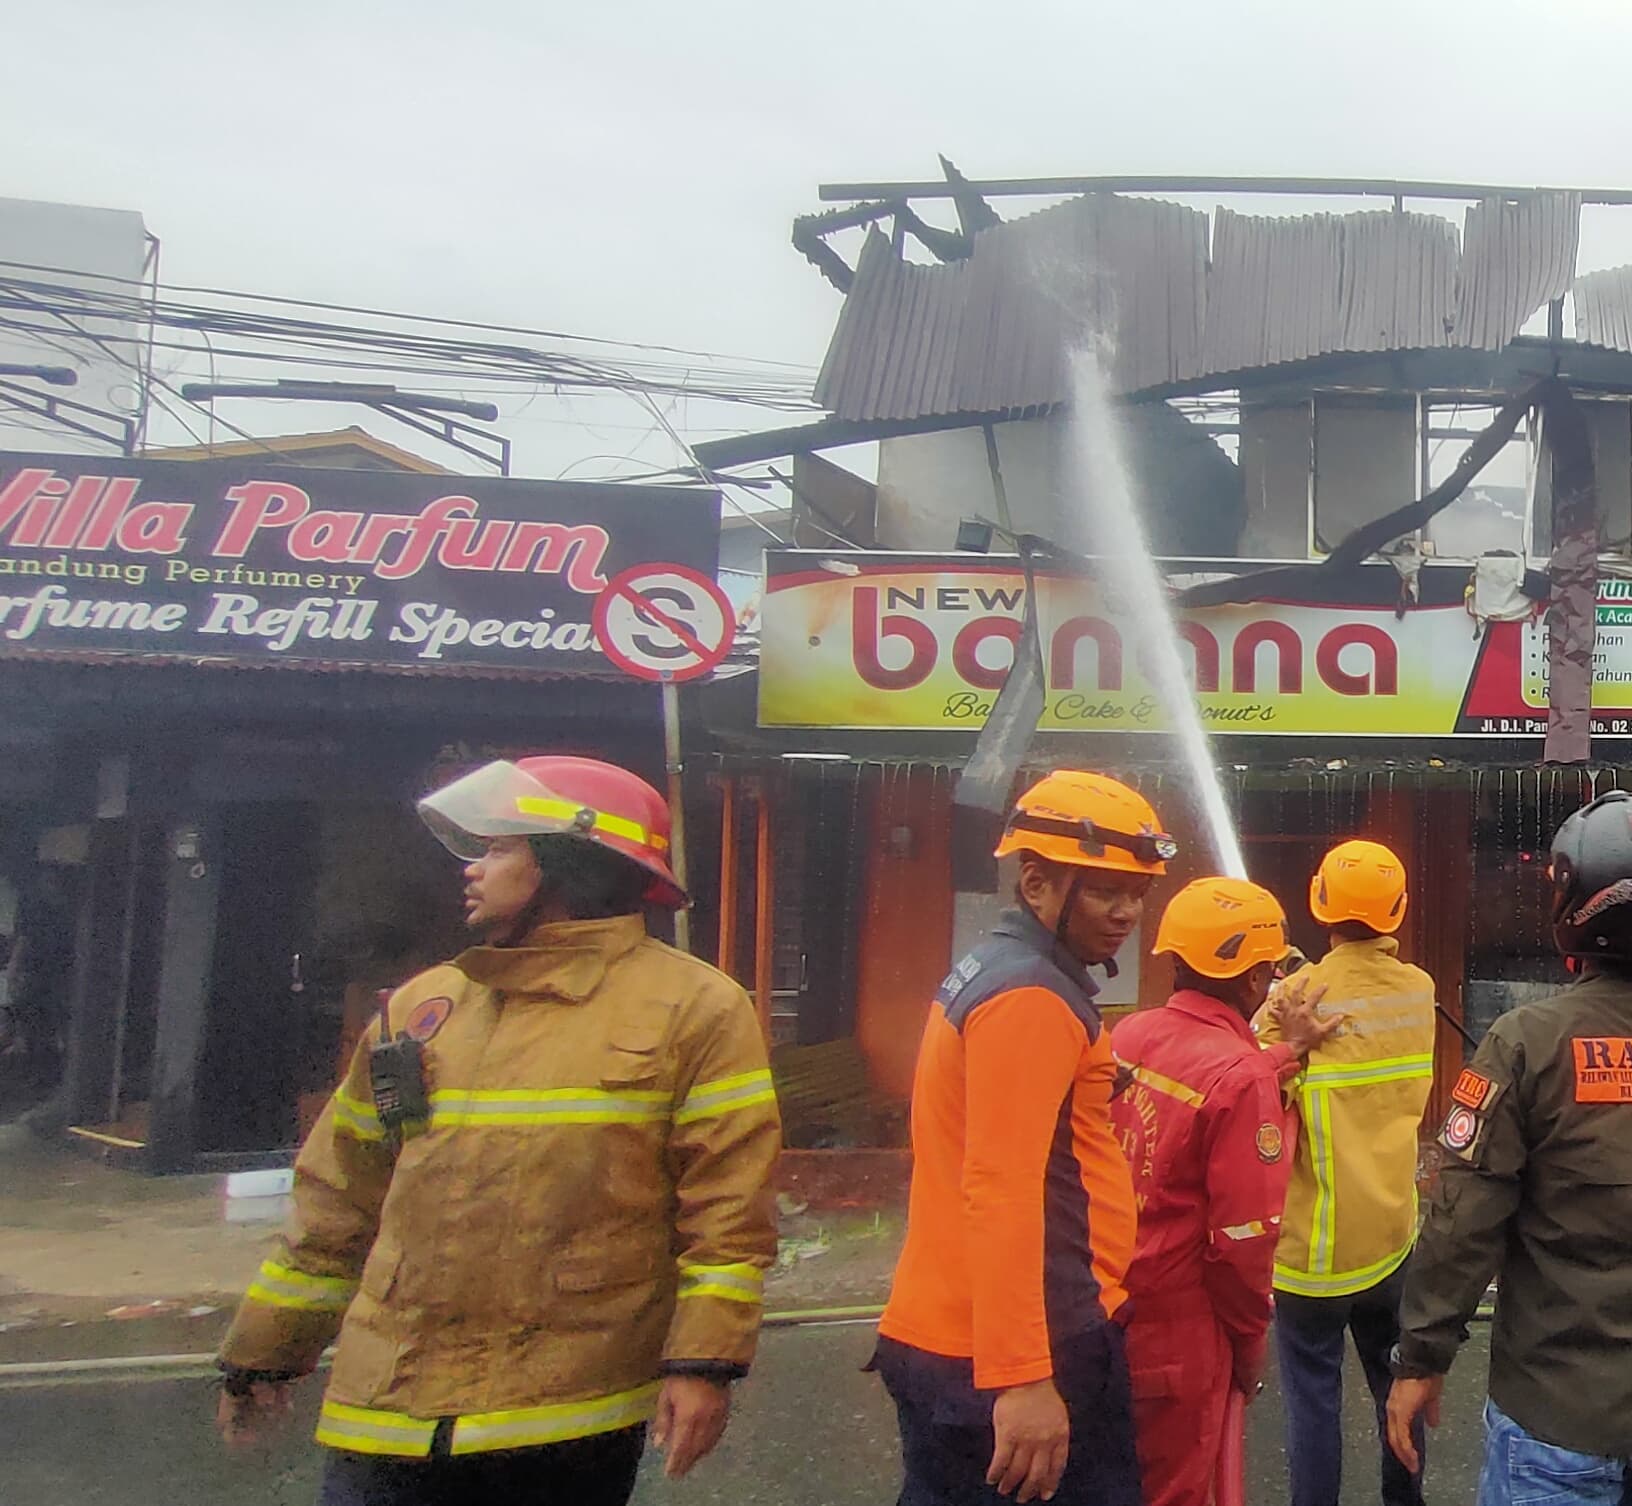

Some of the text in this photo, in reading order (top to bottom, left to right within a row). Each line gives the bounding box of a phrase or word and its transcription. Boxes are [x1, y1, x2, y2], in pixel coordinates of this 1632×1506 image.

[211, 480, 609, 594] Parfum
[165, 560, 366, 594] Perfumery
[888, 587, 1023, 611] NEW
[198, 592, 380, 651] Refill
[389, 601, 604, 659] Specia
[1054, 694, 1123, 719] Cake
[1197, 700, 1277, 722] onut's
[1481, 719, 1497, 732] Jl.
[1501, 719, 1521, 732] D.I.
[1590, 720, 1608, 733] No.
[1612, 720, 1628, 733] 02
